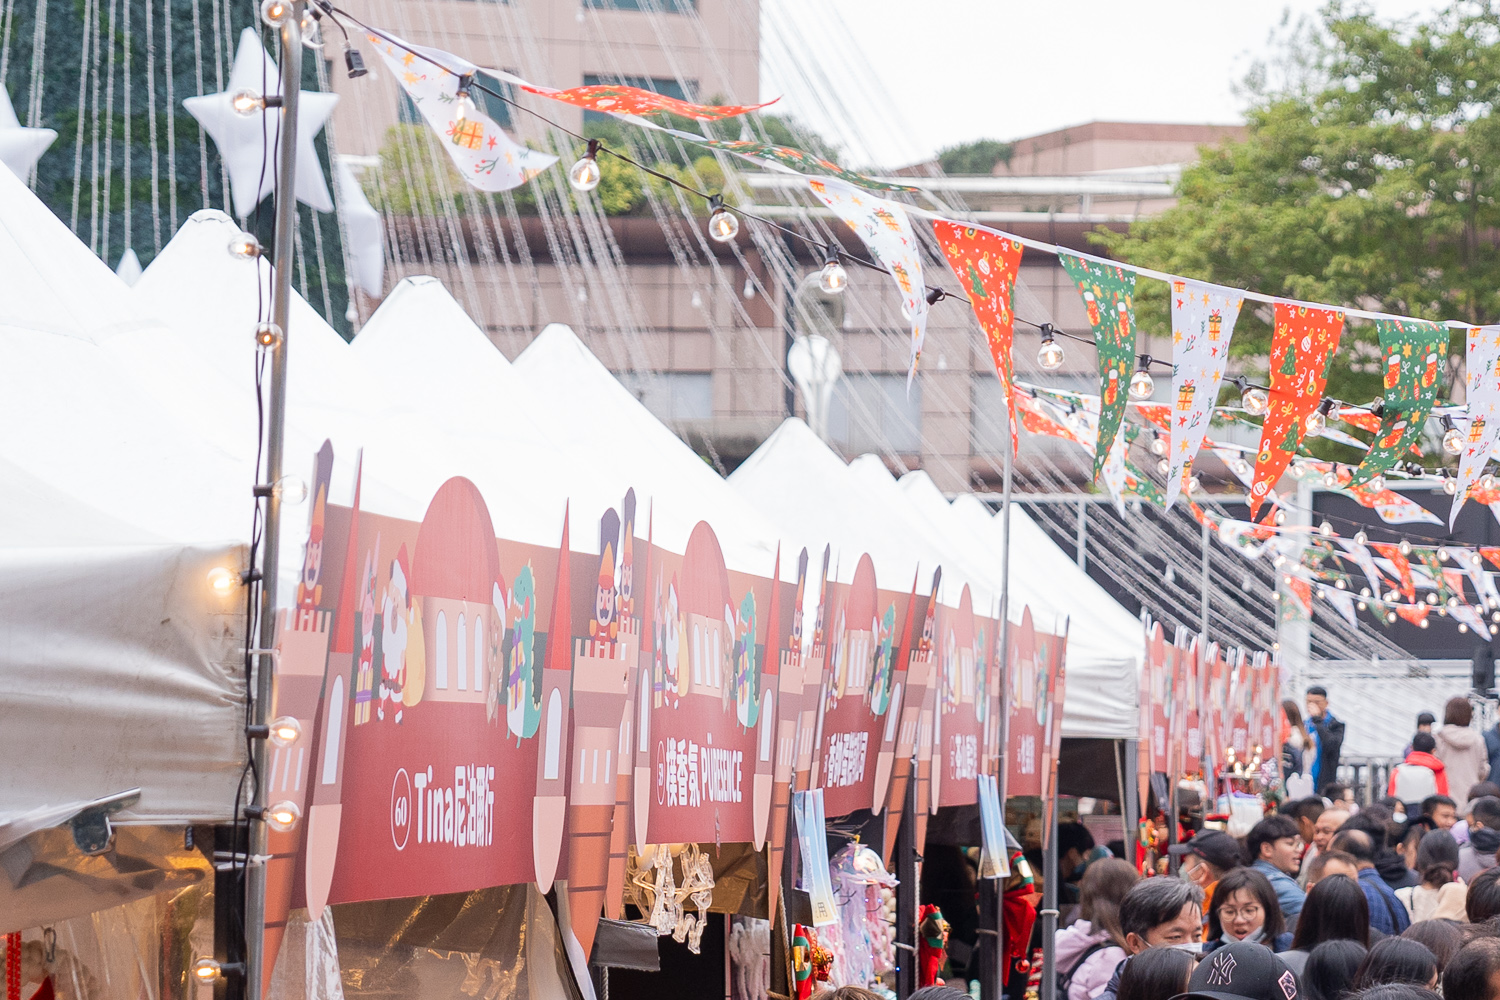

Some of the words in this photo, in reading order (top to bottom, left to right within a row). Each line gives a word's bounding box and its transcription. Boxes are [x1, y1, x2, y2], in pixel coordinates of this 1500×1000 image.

[395, 796, 407, 827] 60
[414, 763, 495, 848] Tina尼泊爾行
[1207, 952, 1238, 985] NY
